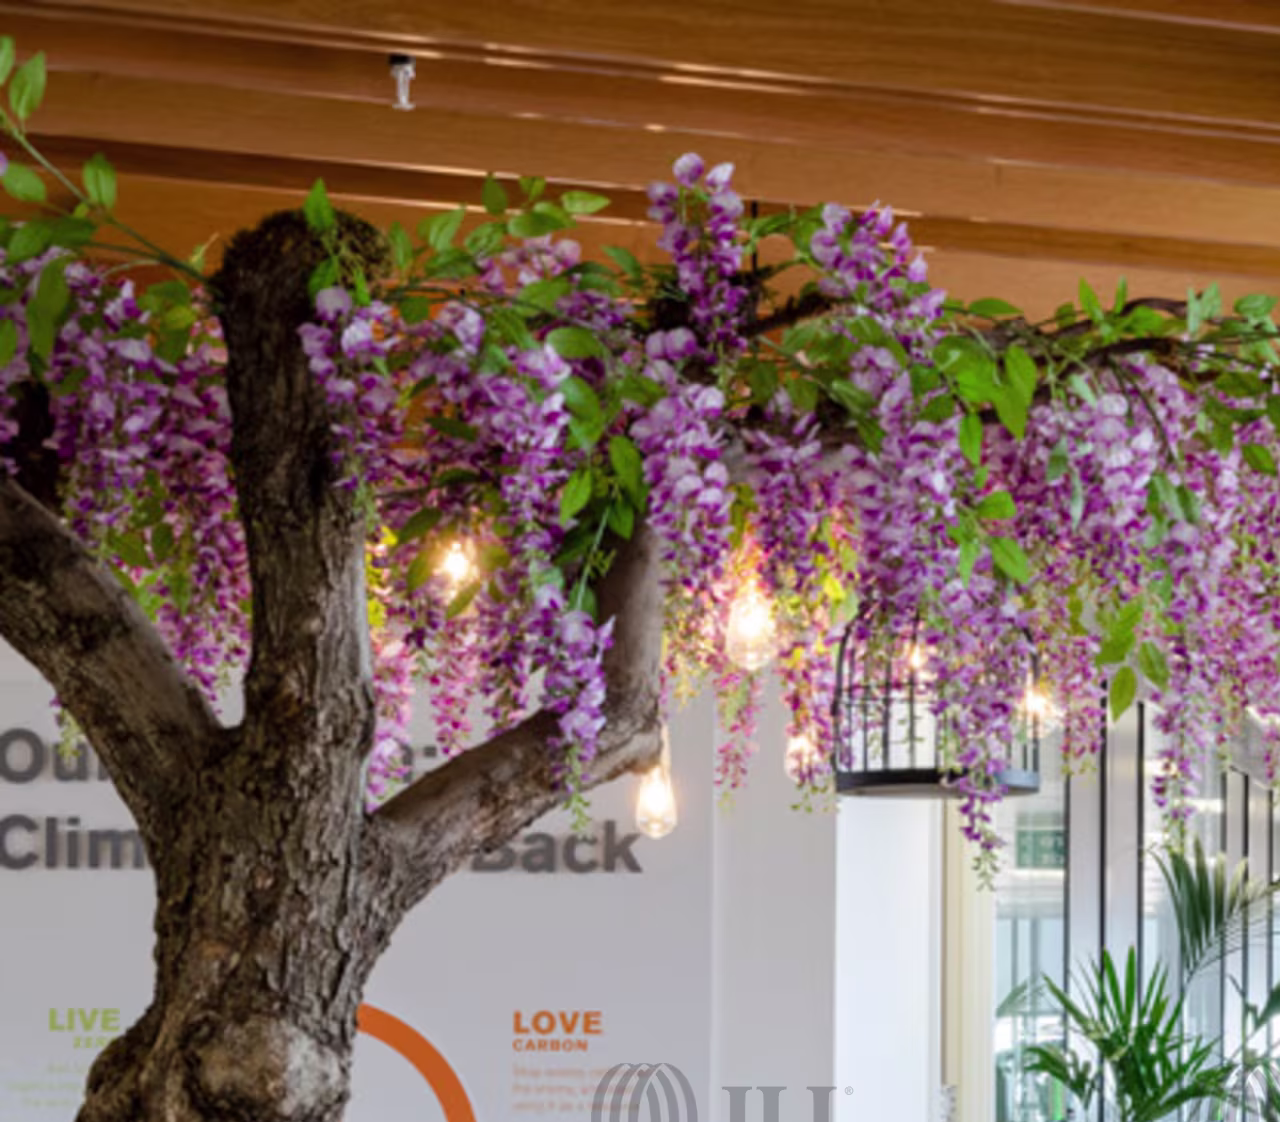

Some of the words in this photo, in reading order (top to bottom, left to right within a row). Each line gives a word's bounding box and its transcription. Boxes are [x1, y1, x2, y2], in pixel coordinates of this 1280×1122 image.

[0, 814, 148, 870] Clim
[49, 1008, 120, 1032] LIVE
[513, 1010, 603, 1035] LOVE
[512, 1039, 588, 1052] CARBON
